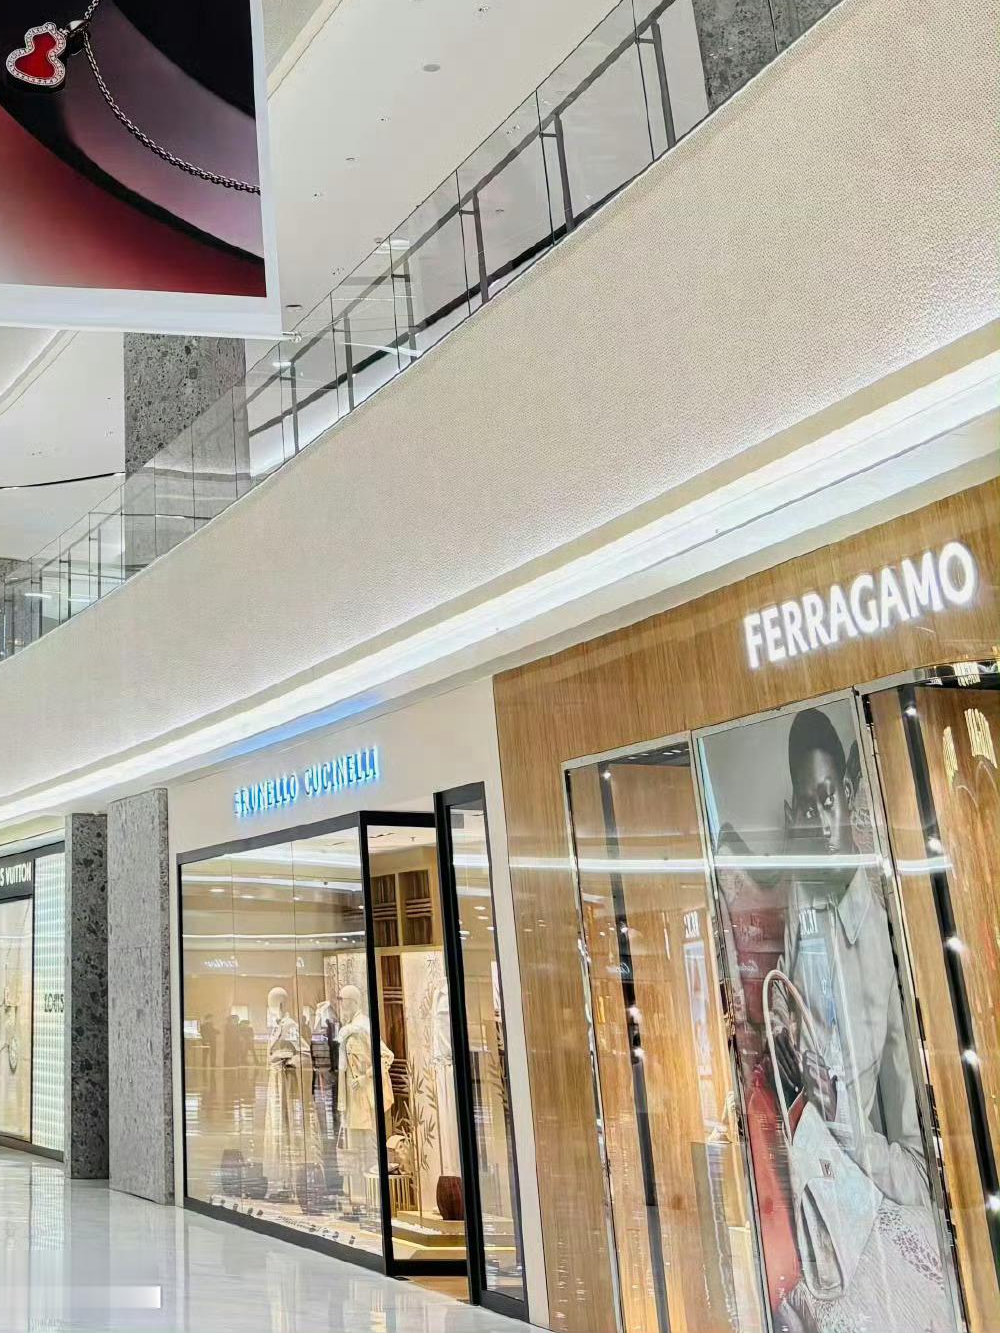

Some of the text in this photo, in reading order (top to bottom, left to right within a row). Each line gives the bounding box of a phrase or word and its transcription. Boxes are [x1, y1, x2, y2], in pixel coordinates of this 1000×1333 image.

[743, 541, 979, 669] FERRAGAMO
[303, 744, 380, 798] CUCINELLI
[5, 861, 32, 885] VUITTON
